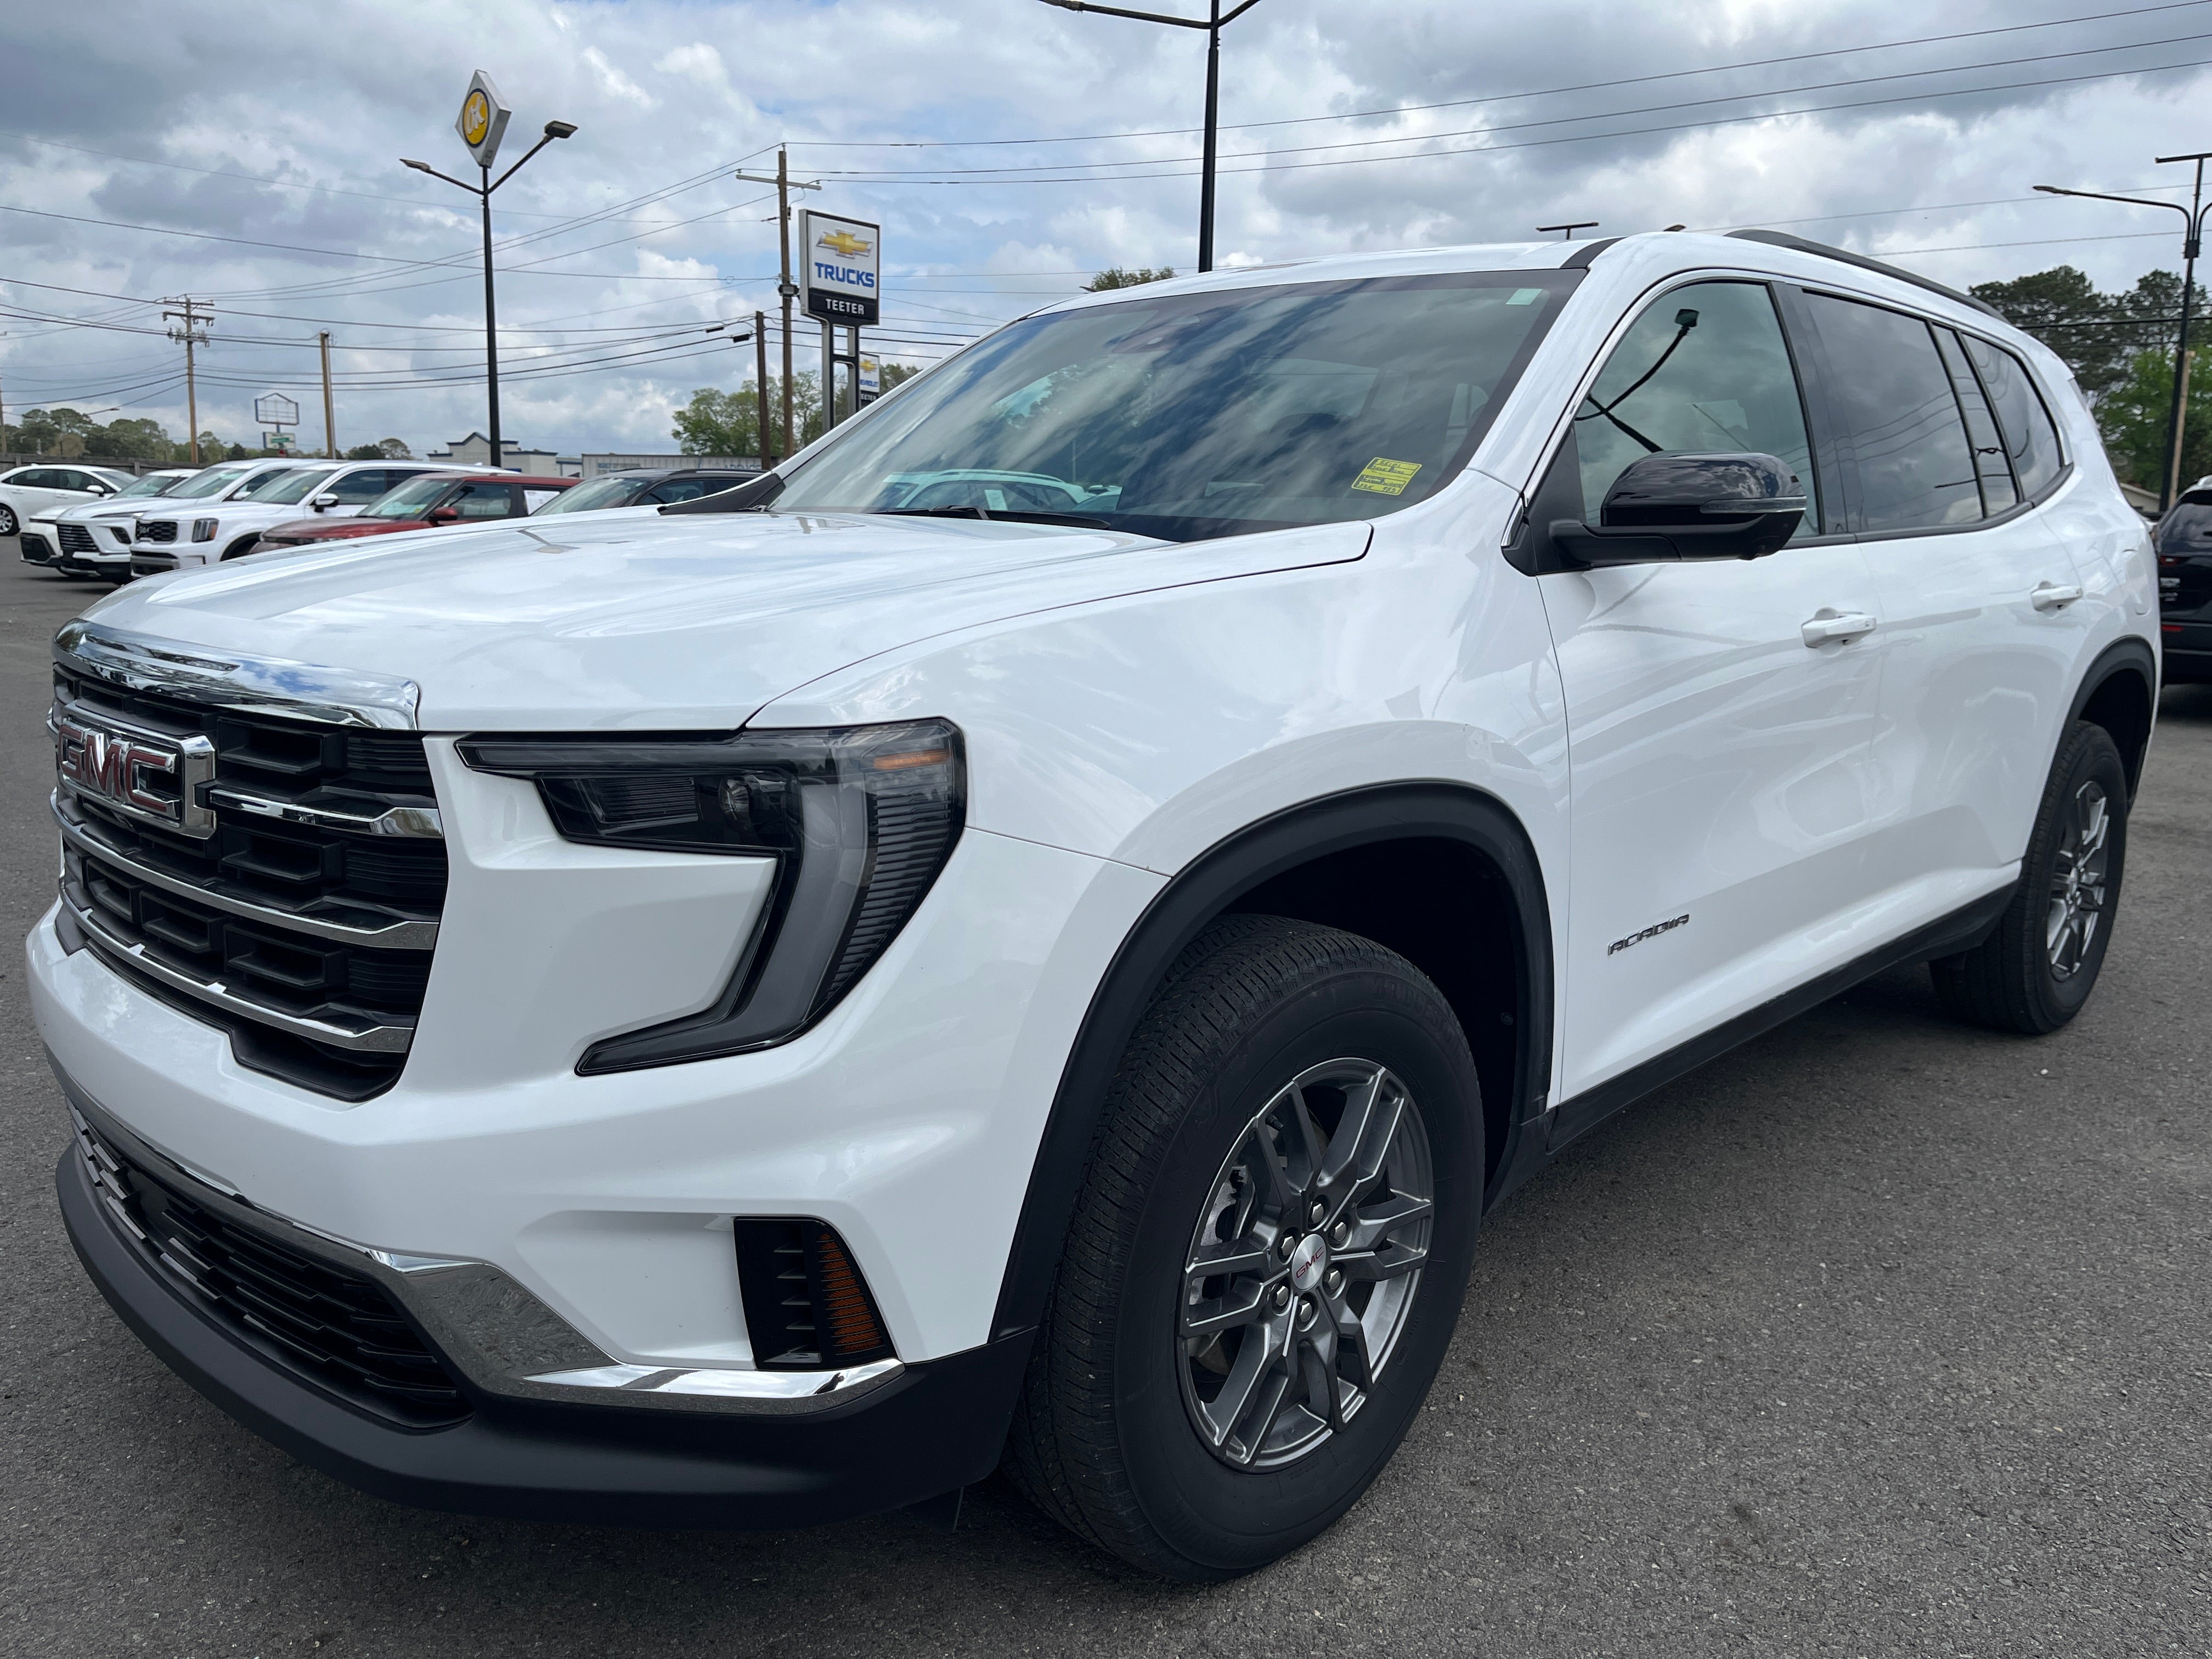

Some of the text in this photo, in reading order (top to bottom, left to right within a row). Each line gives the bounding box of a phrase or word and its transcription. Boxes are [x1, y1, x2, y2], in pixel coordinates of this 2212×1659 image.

[814, 262, 874, 288] TRUCKS
[825, 298, 865, 315] TEETER
[58, 720, 179, 820] GMC
[1607, 914, 1690, 956] ACADIA
[1296, 1245, 1324, 1279] GMC
